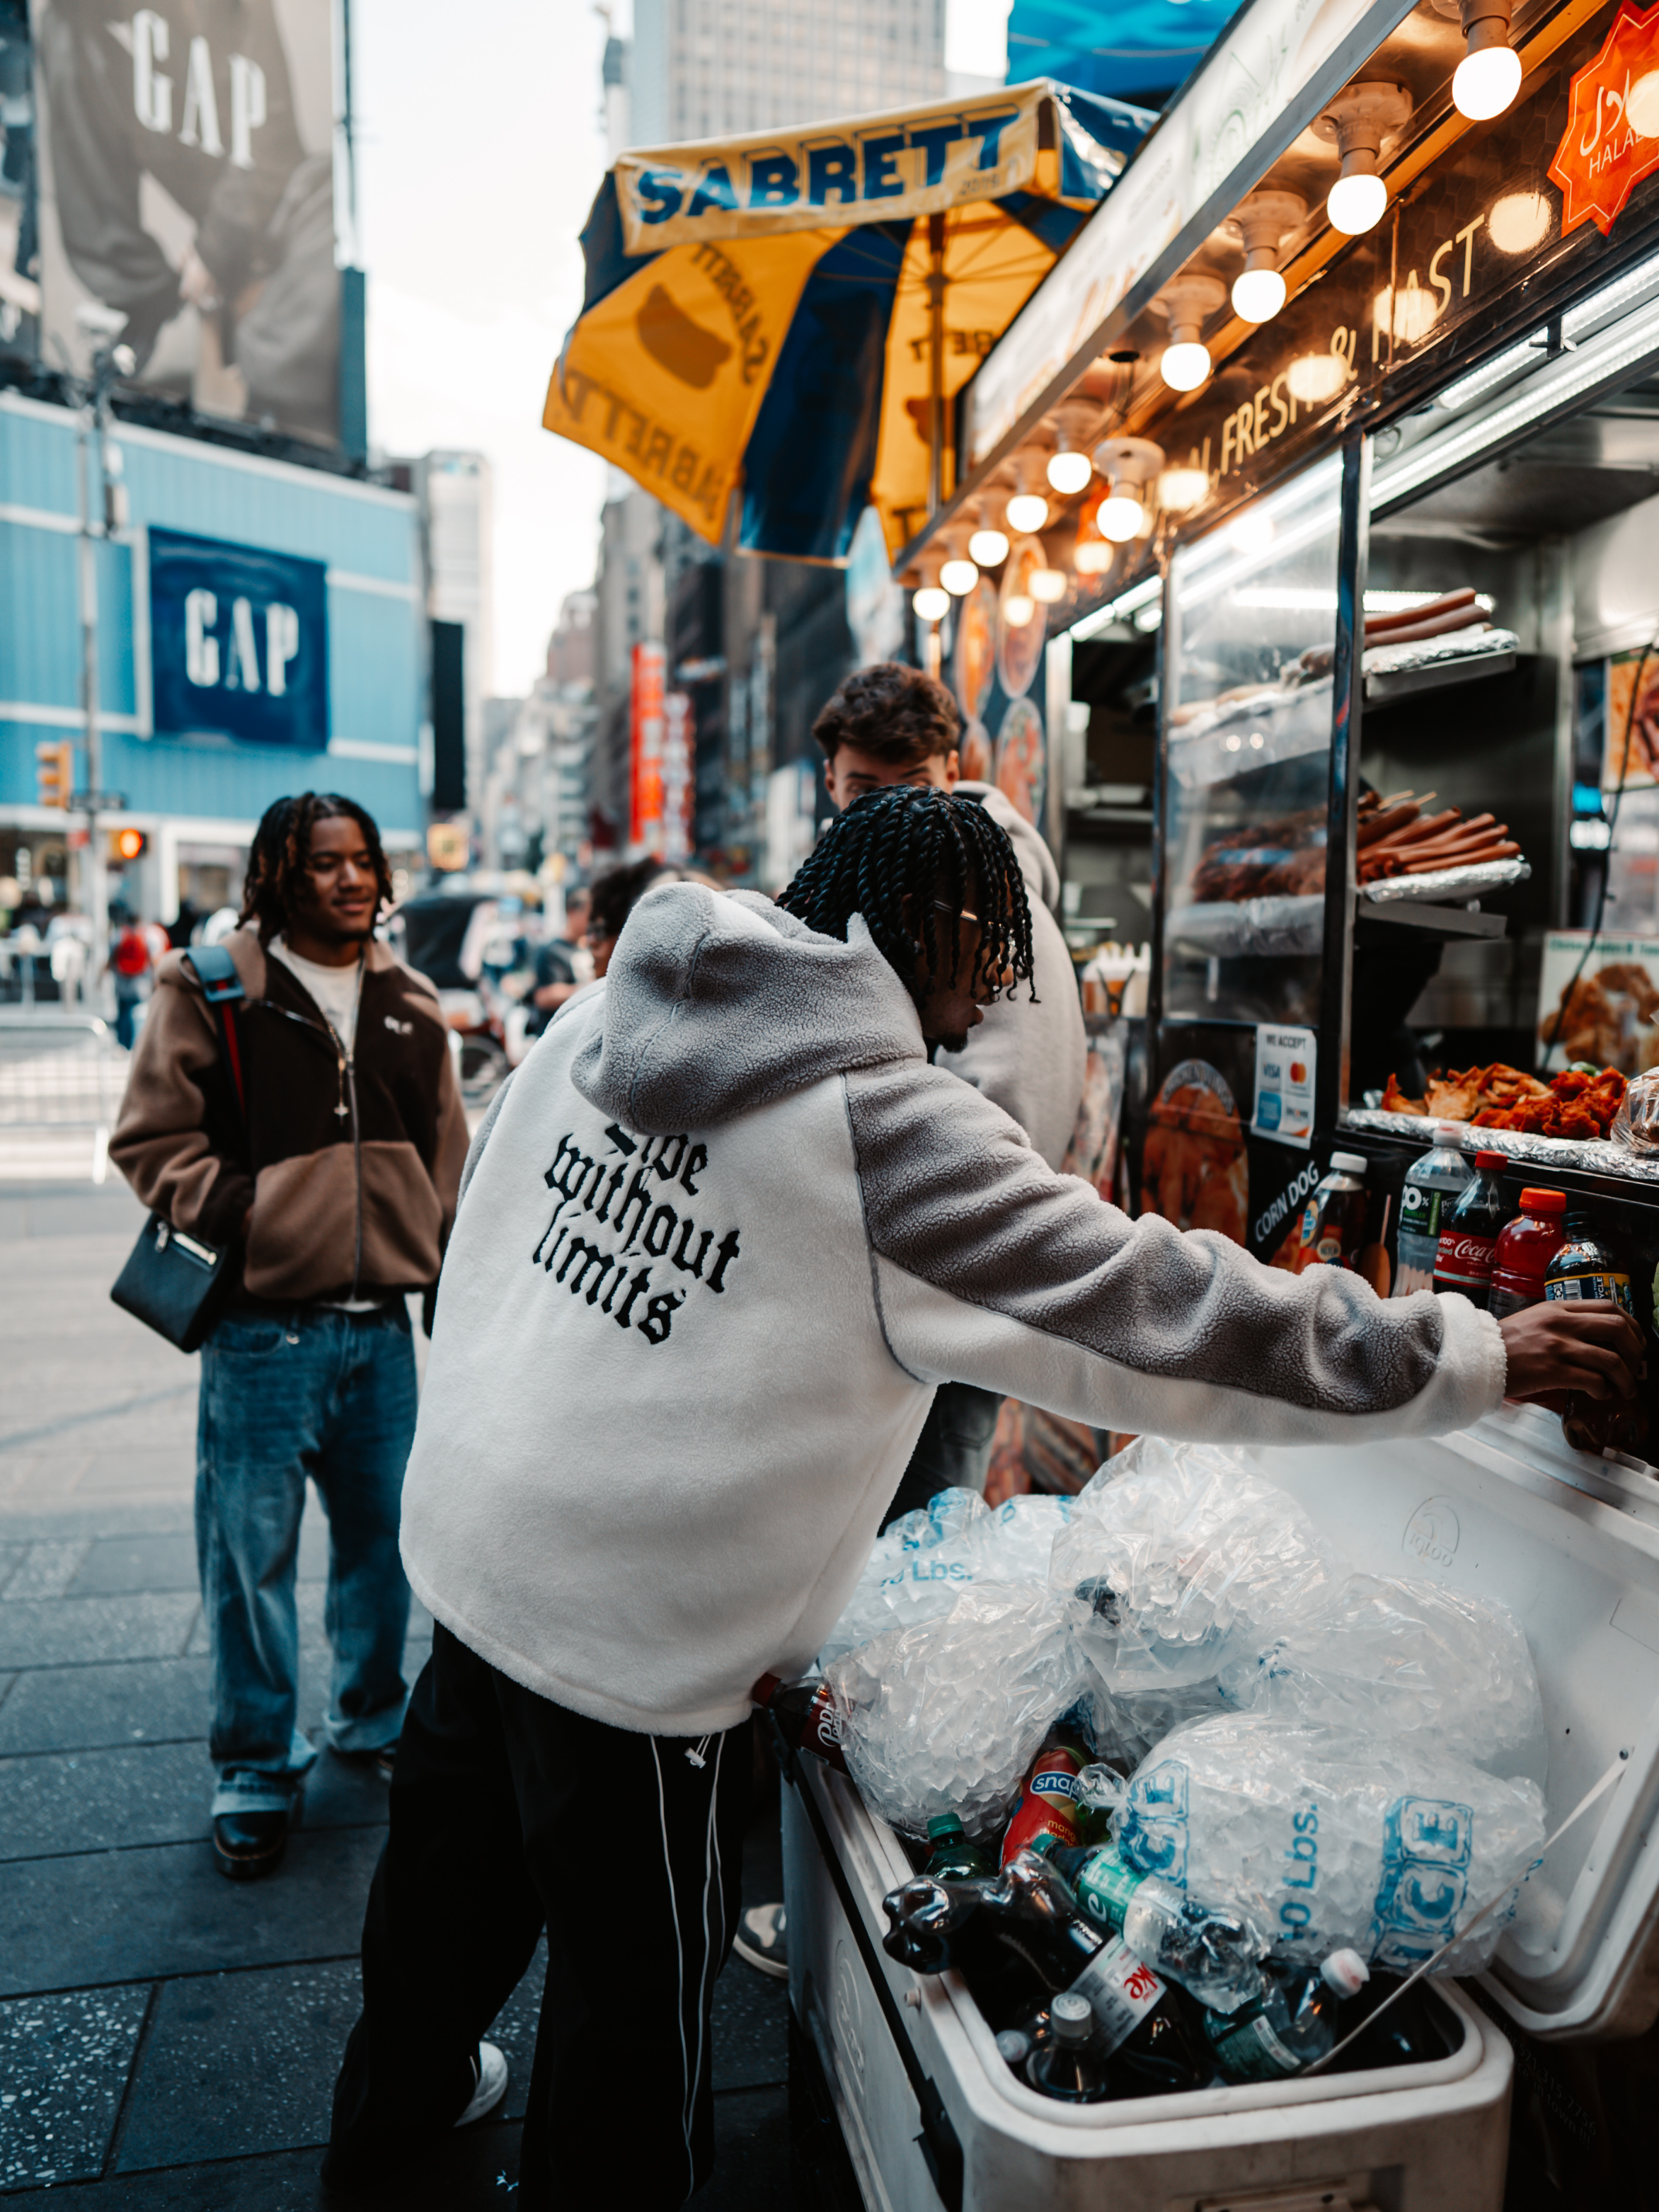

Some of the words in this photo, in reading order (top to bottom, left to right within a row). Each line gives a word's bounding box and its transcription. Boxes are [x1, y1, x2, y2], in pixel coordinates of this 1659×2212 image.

[133, 8, 267, 171] GAP
[635, 103, 1021, 225] SABRETT
[1589, 122, 1644, 179] HALAL
[185, 588, 299, 696] GAP
[1263, 1063, 1281, 1079] VISA
[1266, 1035, 1276, 1047] WE
[1278, 1036, 1307, 1050] ACCEPT
[544, 1133, 740, 1293] without
[1256, 1192, 1288, 1242] CORN
[1288, 1160, 1319, 1207] DOG
[532, 1202, 687, 1345] limits
[912, 1560, 973, 1581] Lbs.
[1035, 1774, 1079, 1799] snap
[1047, 1820, 1078, 1843] mang
[1282, 1804, 1319, 1889] Lbs.
[1534, 2077, 1544, 2097] in
[1548, 2094, 1576, 2133] town
